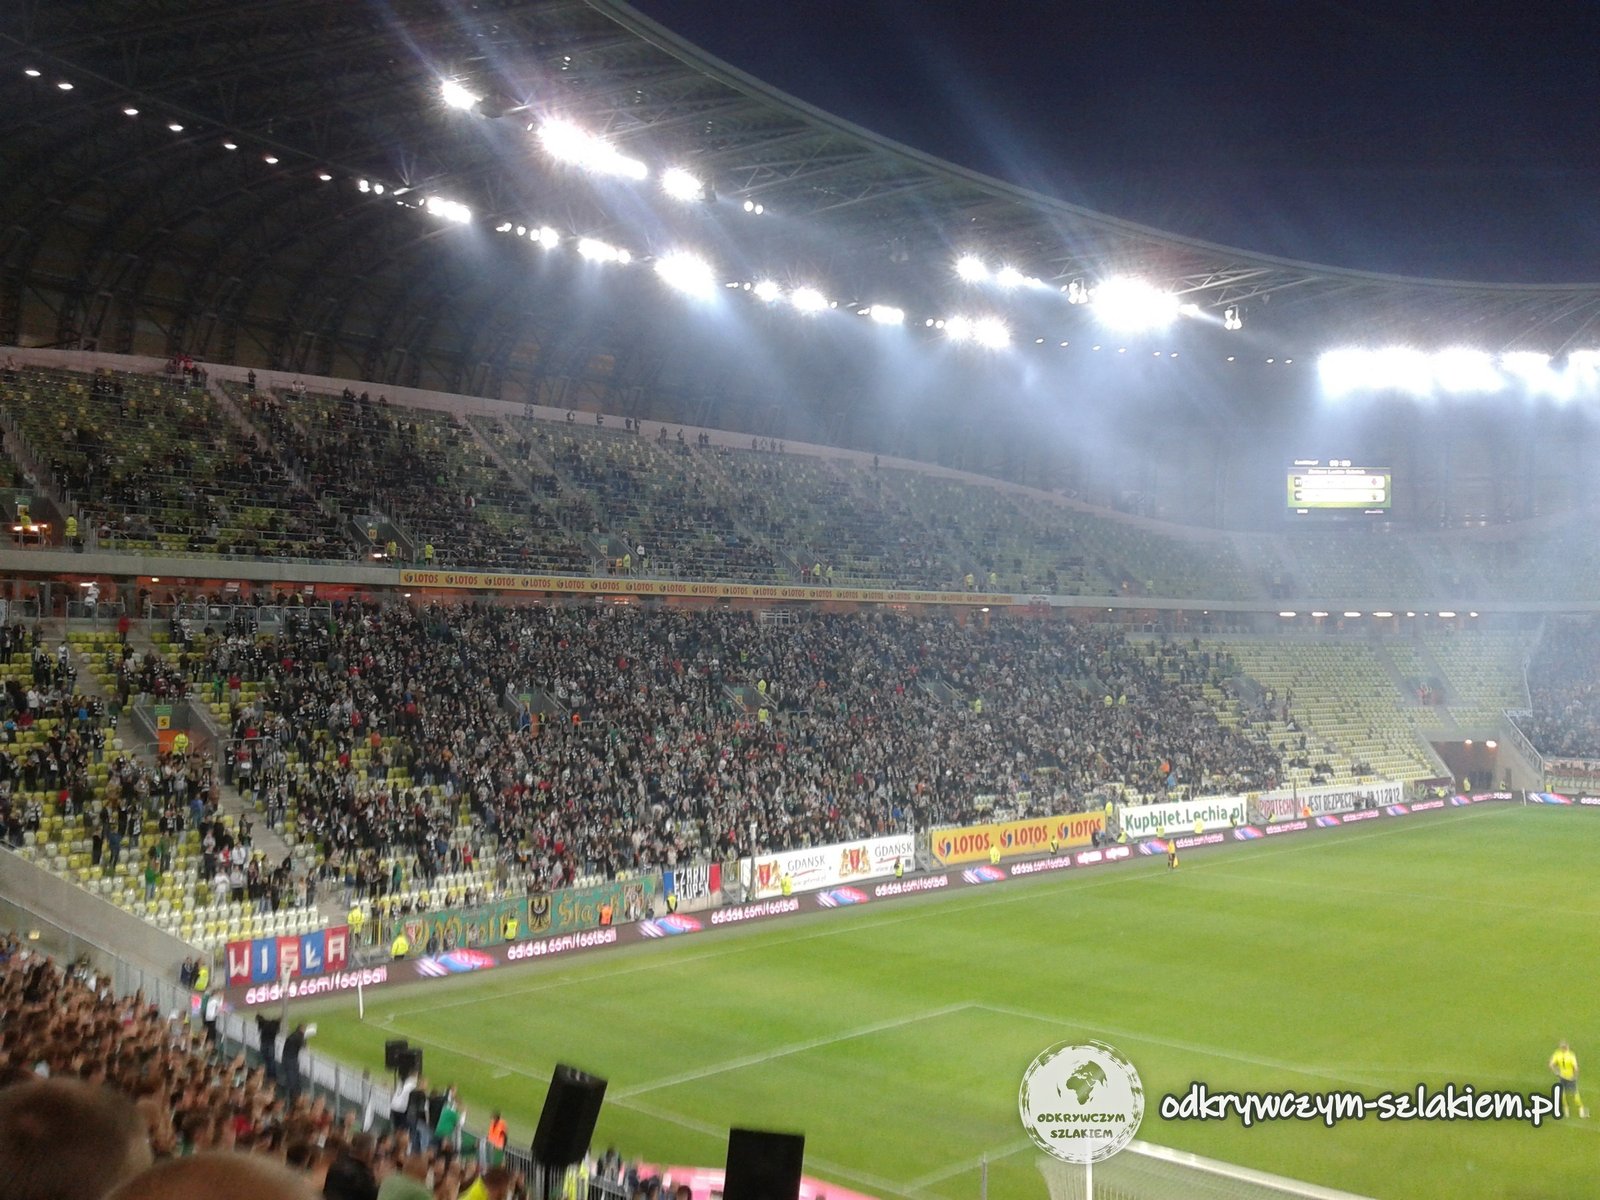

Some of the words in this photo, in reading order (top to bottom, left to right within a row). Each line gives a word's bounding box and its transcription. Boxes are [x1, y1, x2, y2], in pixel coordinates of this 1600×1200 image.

[414, 574, 439, 583] LOTOS
[455, 576, 478, 585] LOTOS
[493, 577, 516, 586] LOTOS
[529, 579, 551, 588] LOTOS
[564, 580, 585, 589] LOTOS
[599, 581, 620, 590] LOTOS
[633, 583, 654, 592] LOTOS
[666, 584, 687, 593] LOTOS
[698, 585, 718, 593] LOTOS
[953, 833, 990, 855] LOTOS
[1014, 825, 1048, 846] LOTOS
[1070, 818, 1101, 838] LOTOS
[229, 935, 346, 978] WISŁA
[507, 926, 617, 960] adidas.com/football
[245, 965, 388, 1005] adids.com/football
